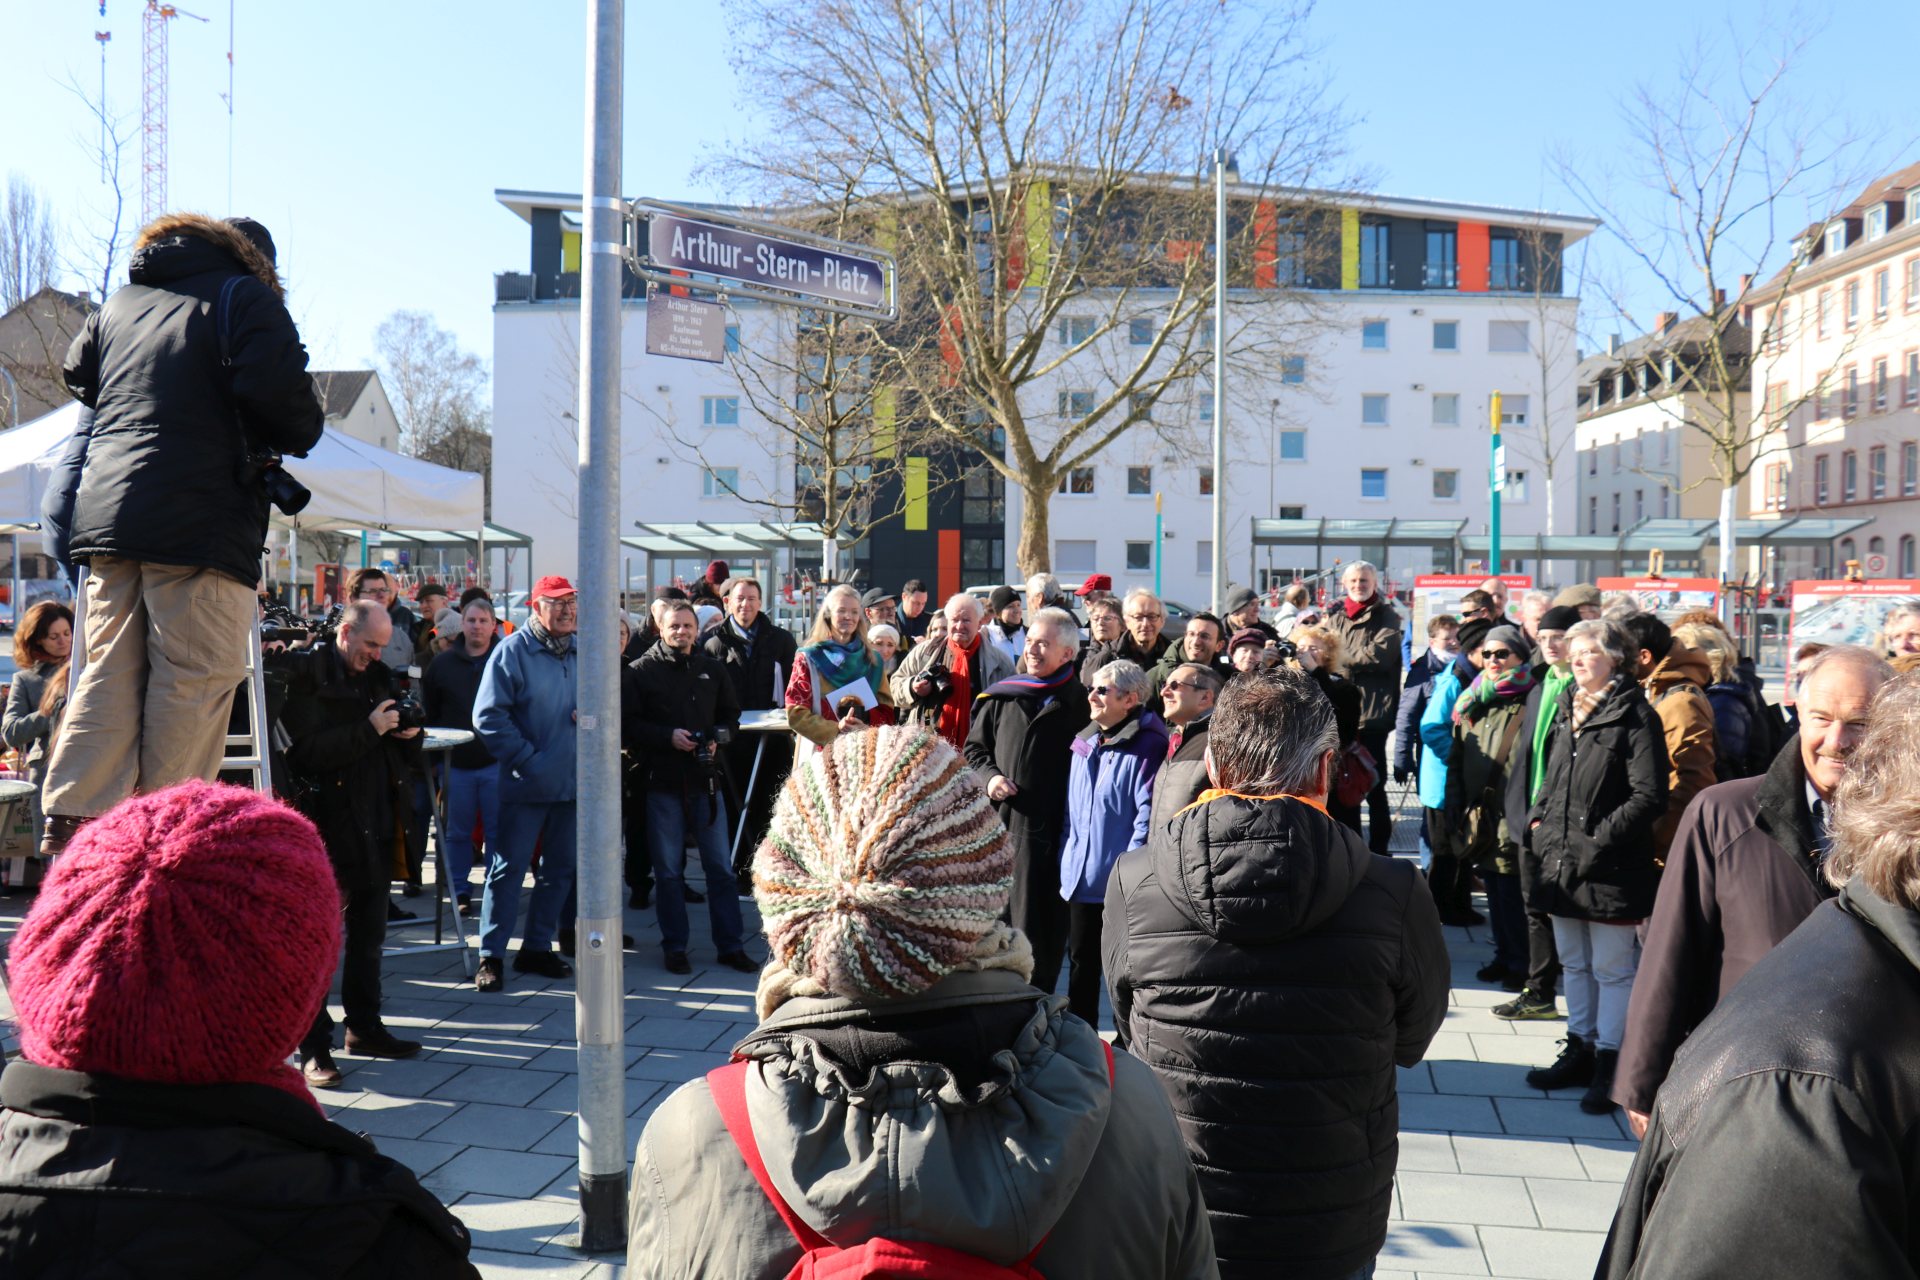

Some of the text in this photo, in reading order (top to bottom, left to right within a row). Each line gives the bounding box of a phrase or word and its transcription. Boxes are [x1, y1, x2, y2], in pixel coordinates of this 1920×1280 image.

[670, 225, 870, 296] Arthur-Stern-Platz
[667, 300, 708, 315] Arthur Stern
